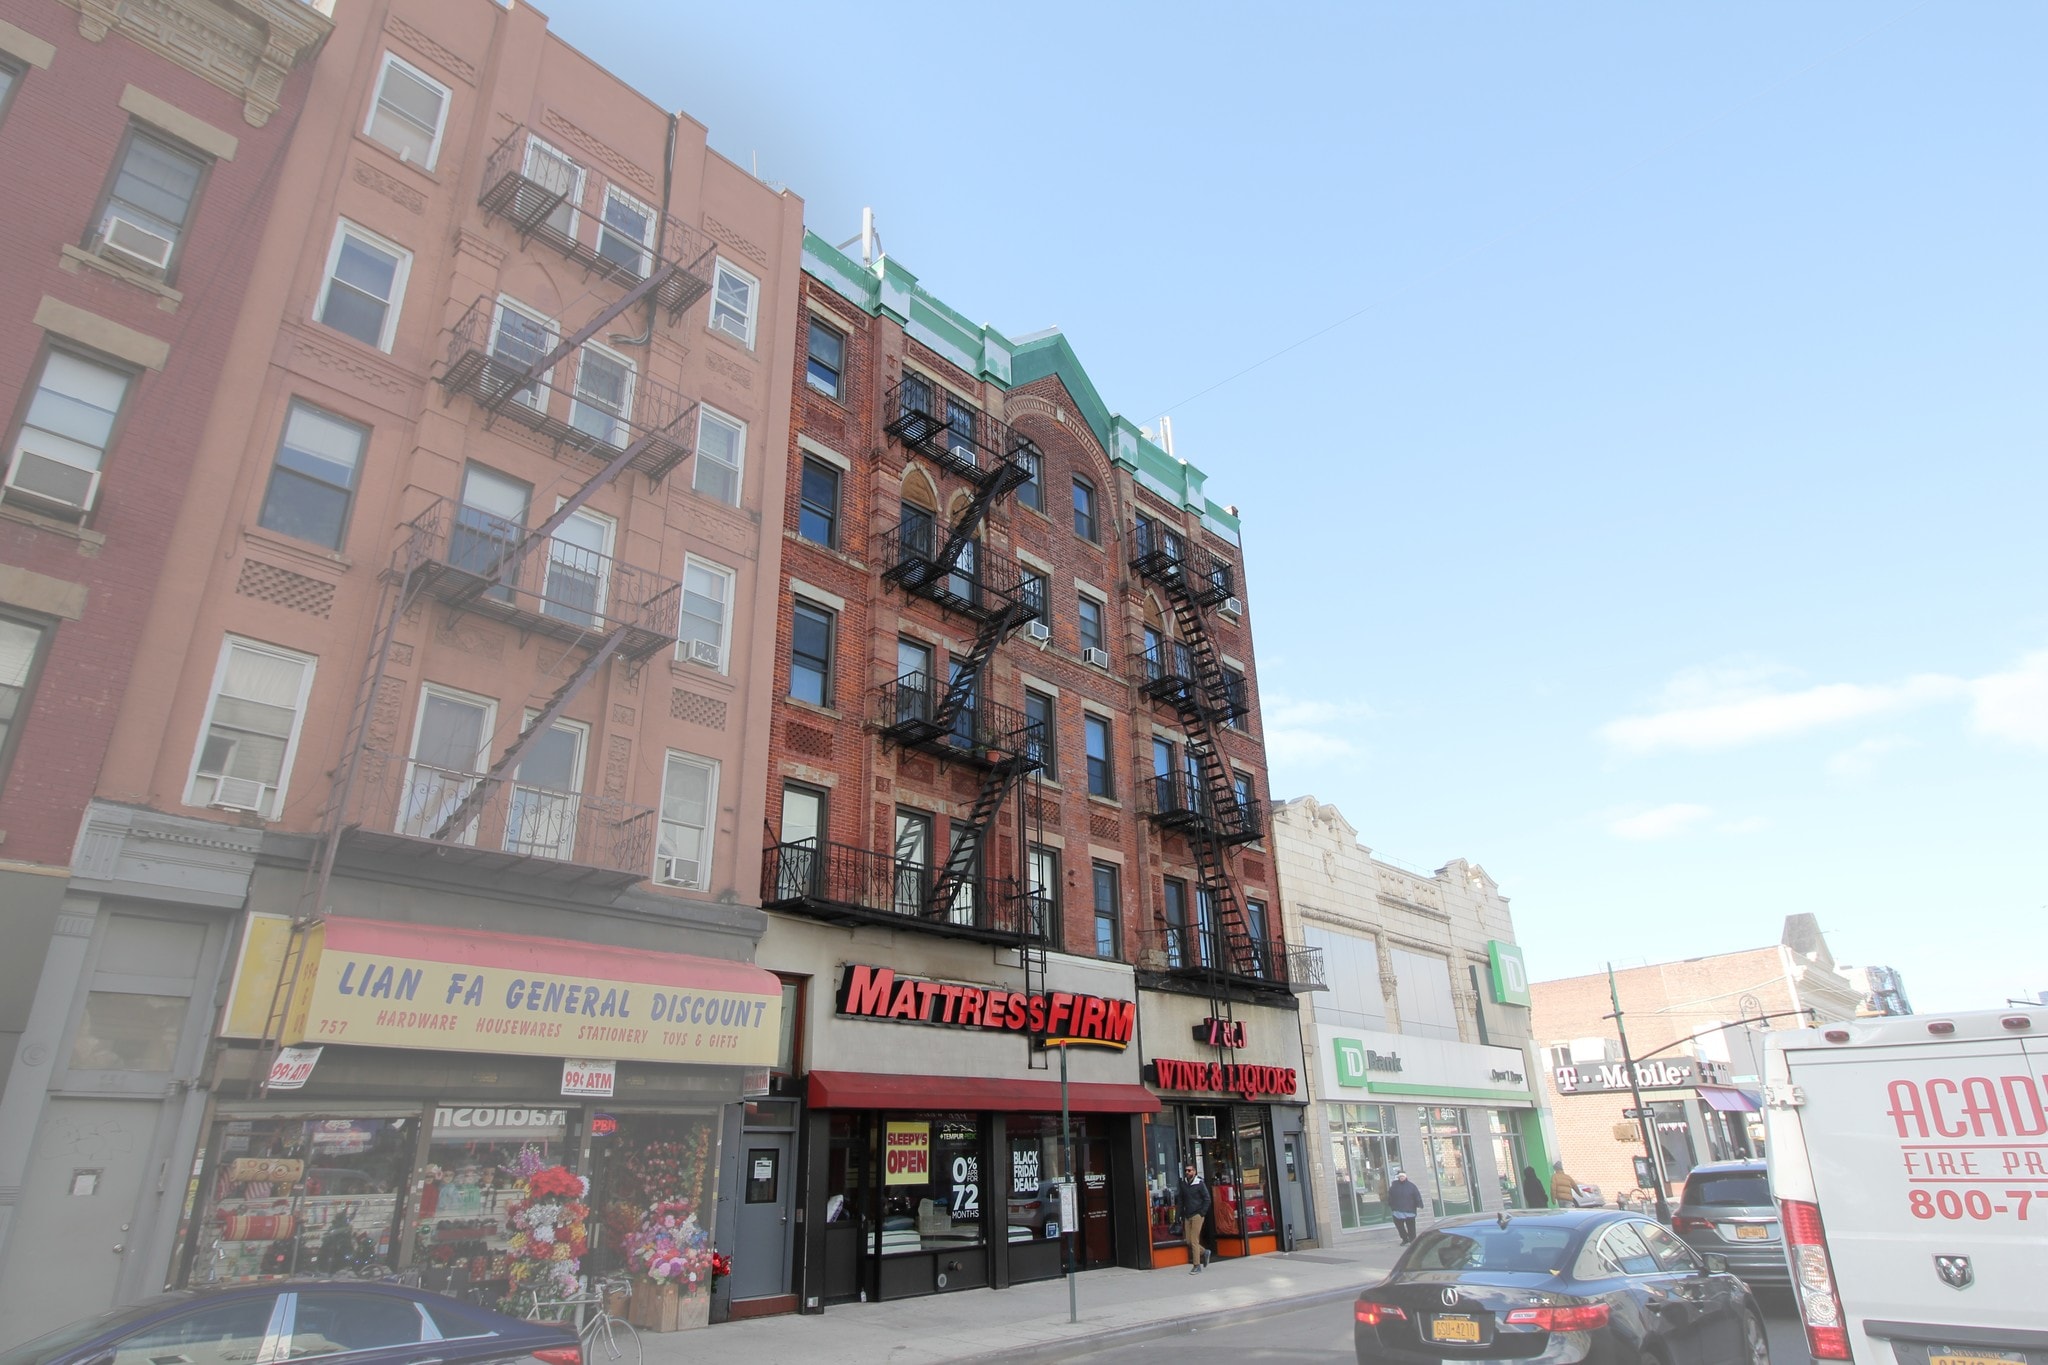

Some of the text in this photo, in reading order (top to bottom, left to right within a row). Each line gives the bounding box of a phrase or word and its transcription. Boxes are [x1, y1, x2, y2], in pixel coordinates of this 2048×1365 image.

[1500, 953, 1526, 993] TD
[338, 961, 766, 1028] LIAN FA GENERAL DISCOUNT
[319, 1019, 348, 1035] 757
[376, 1010, 738, 1048] HARDWARE HOUSEWARES STATIONERY TOYS & GIFTS
[1238, 1021, 1247, 1049] J
[1342, 1047, 1403, 1077] TD Bank
[270, 1063, 313, 1080] 99¢ ATM
[565, 1071, 584, 1087] 99¢
[586, 1073, 612, 1089] ATM
[1156, 1059, 1296, 1101] WINE & LIQUORS
[1491, 1069, 1507, 1082] Open
[1510, 1071, 1523, 1084] Days
[592, 1119, 617, 1133] PEN
[887, 1133, 928, 1146] SLEEPY'S
[887, 1150, 928, 1174] OPEN
[1013, 1151, 1039, 1164] BLACK
[1903, 1152, 1980, 1175] FIRE
[1014, 1165, 1039, 1178] FRIDAY
[1014, 1178, 1039, 1192] DEALS
[952, 1184, 979, 1211] 72
[952, 1210, 979, 1219] MONTHS
[1952, 1349, 2001, 1359] NEW YORK
